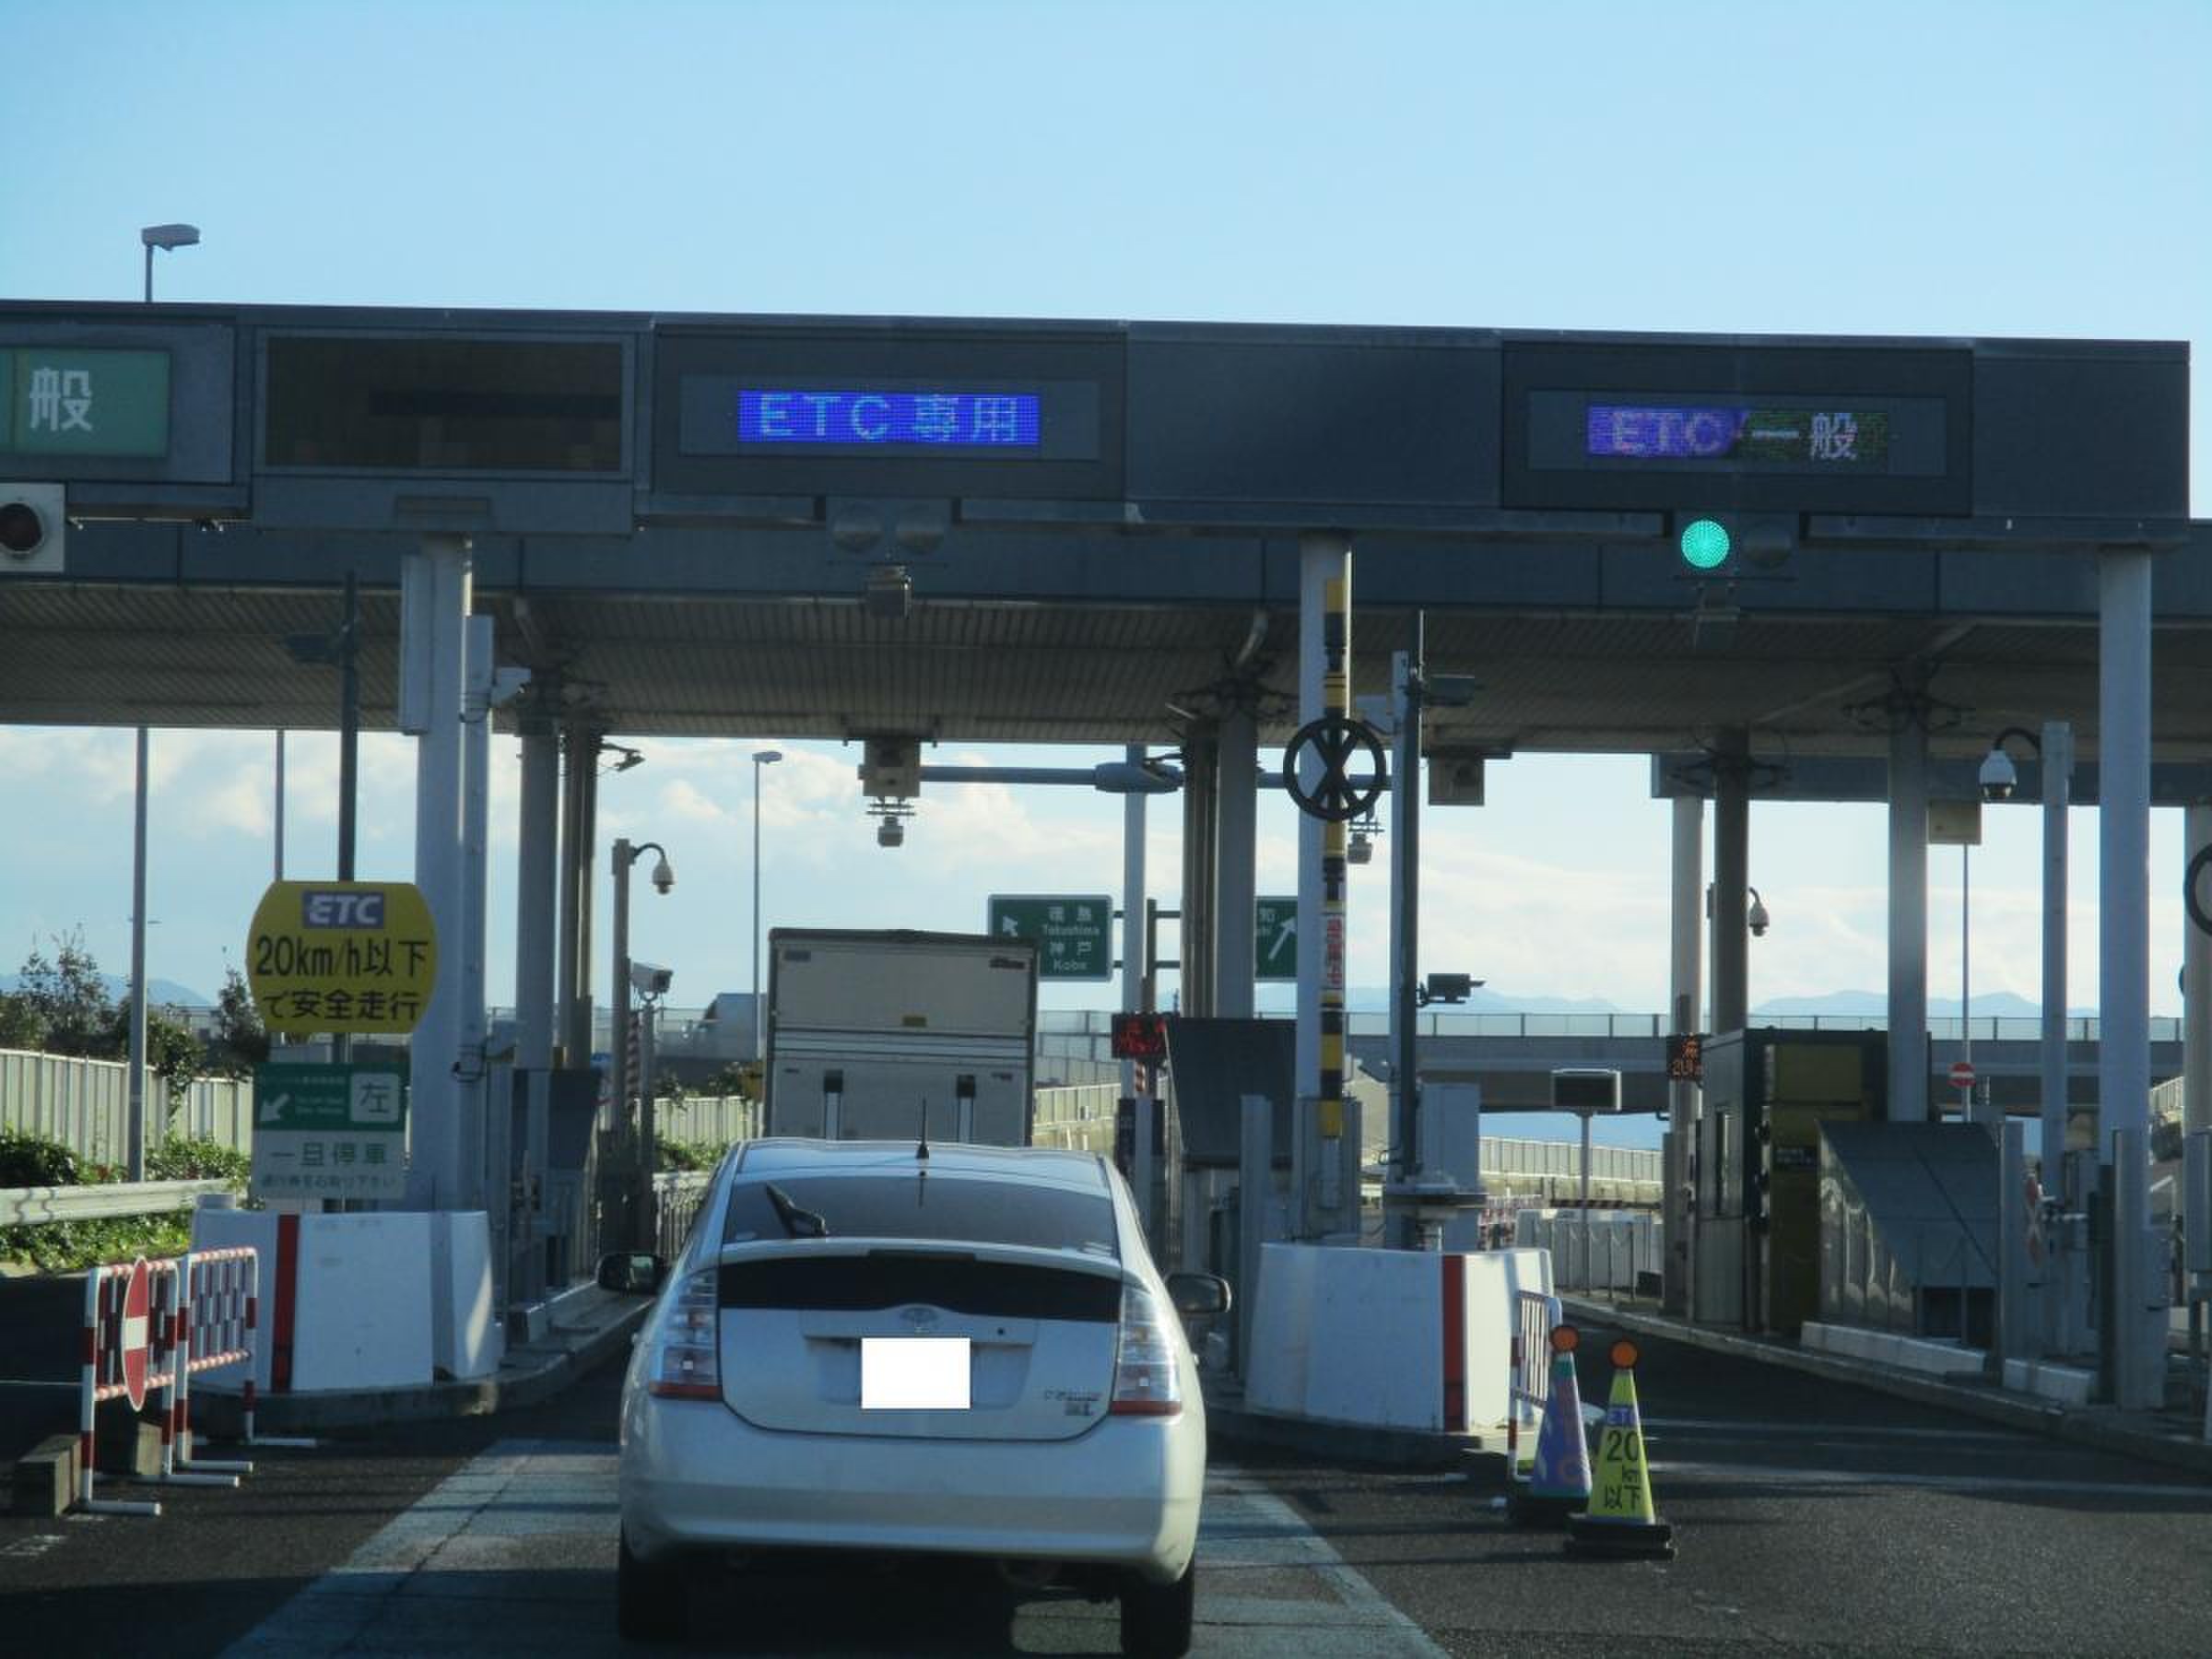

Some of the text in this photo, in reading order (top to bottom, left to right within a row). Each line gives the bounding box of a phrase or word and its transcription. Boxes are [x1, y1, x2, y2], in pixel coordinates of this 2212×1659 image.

[29, 368, 93, 431] 般
[760, 394, 1018, 442] ETC 専用
[1614, 411, 1858, 460] ETC 一般
[309, 894, 382, 924] ETC
[255, 935, 429, 978] 20km/h以下
[264, 989, 419, 1021] で安全走行
[359, 1082, 391, 1114] 左
[1606, 1430, 1639, 1462] 20
[1604, 1484, 1641, 1511] 以下
